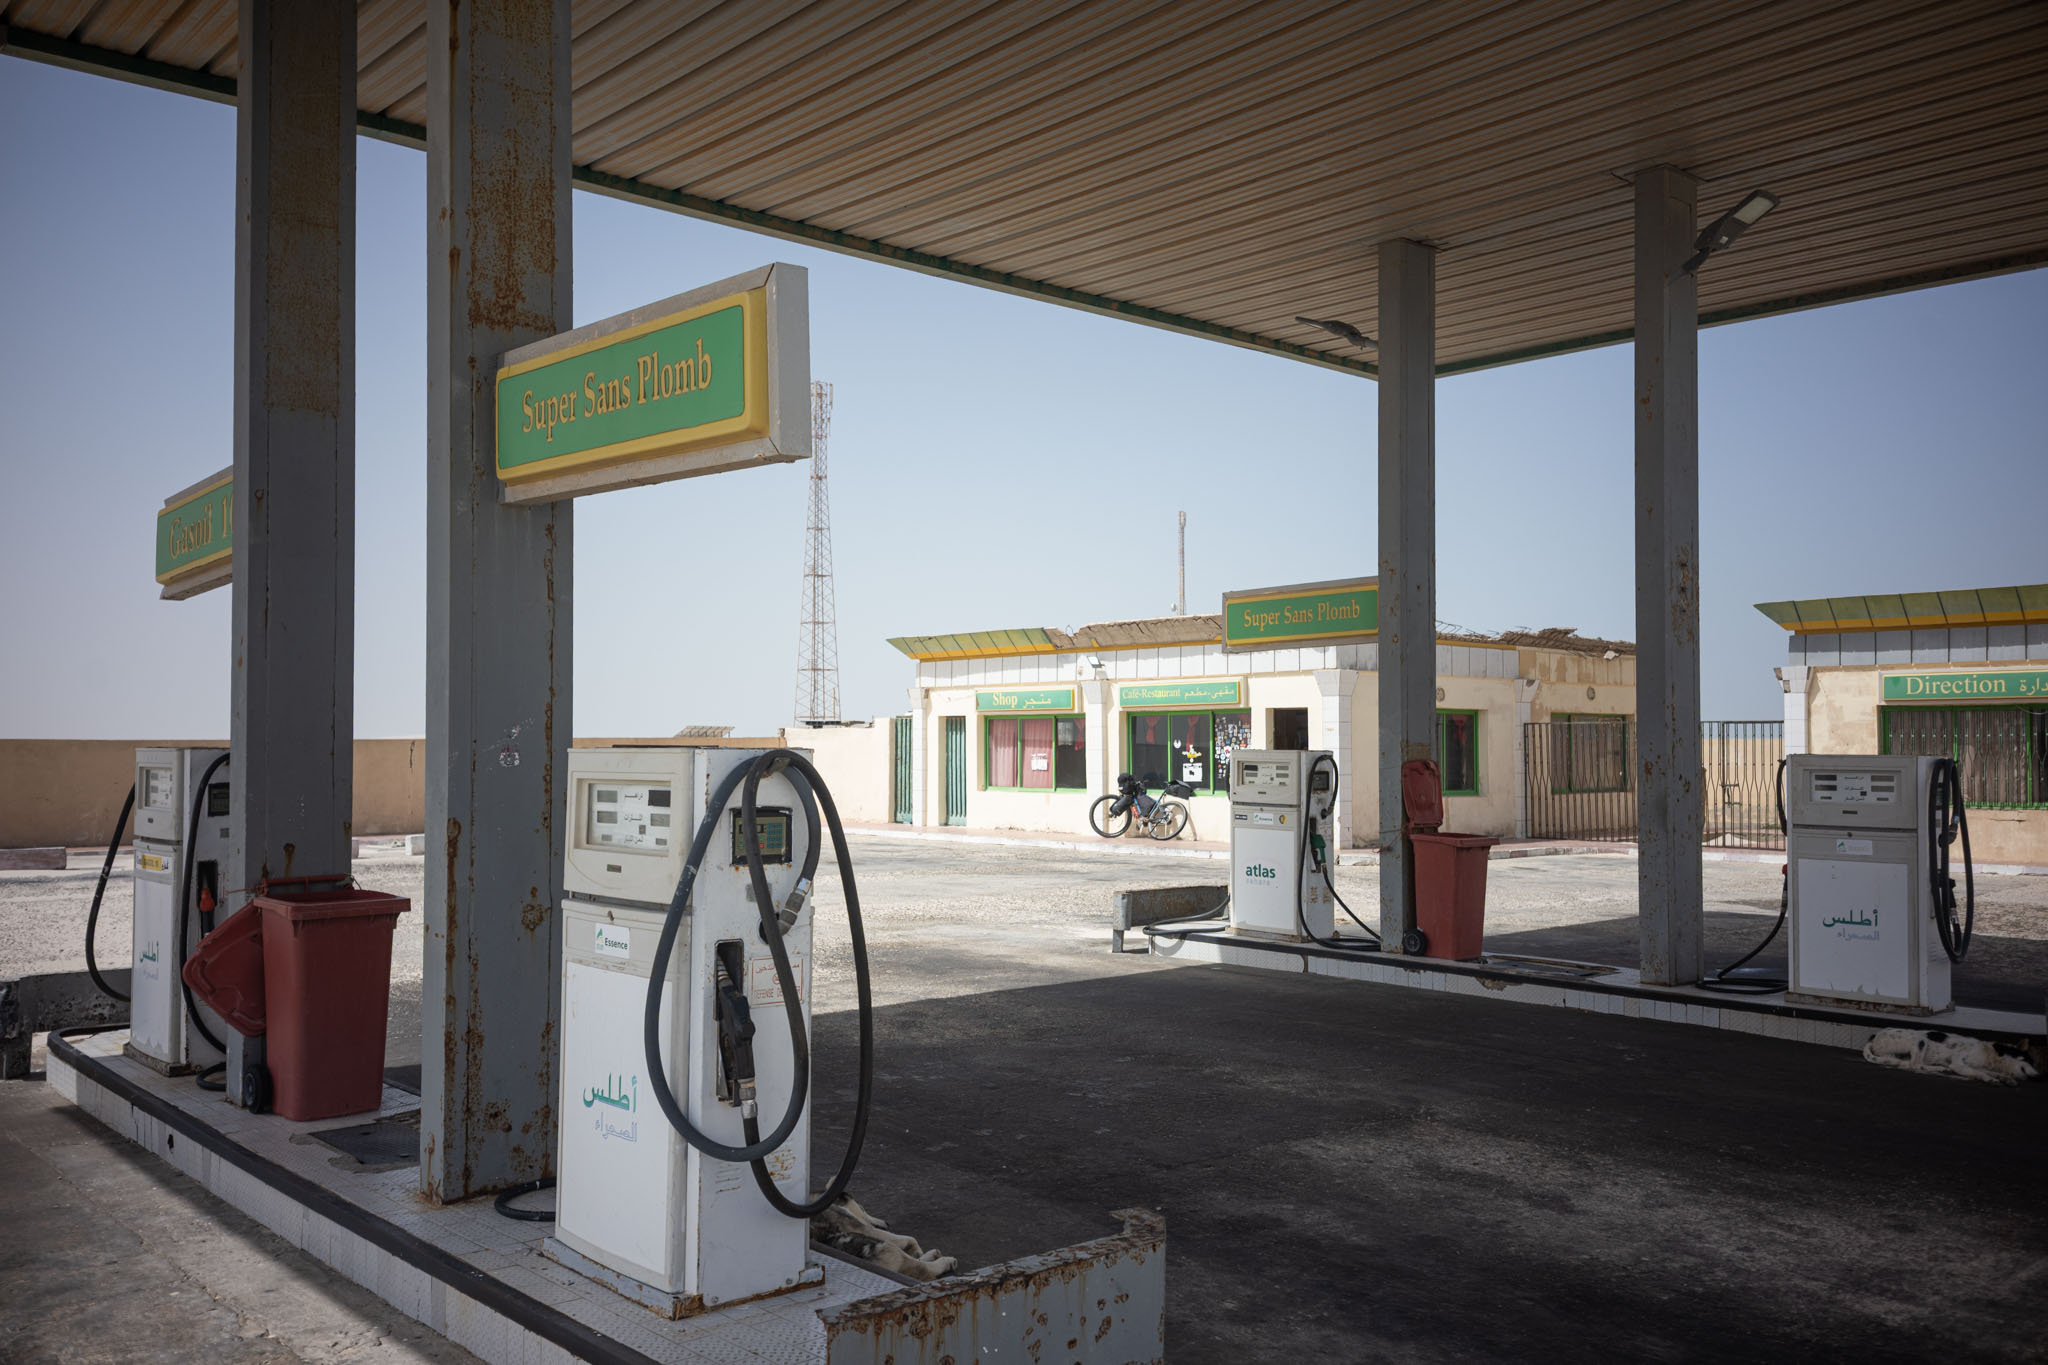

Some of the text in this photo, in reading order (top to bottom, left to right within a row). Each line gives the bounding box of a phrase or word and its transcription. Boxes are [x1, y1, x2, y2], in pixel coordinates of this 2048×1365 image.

[522, 338, 713, 442] Super Sans Plomb
[168, 503, 213, 559] Gasoil
[1243, 599, 1361, 631] Super Sans Plomb
[1905, 674, 2007, 695] Direction
[992, 691, 1018, 709] Shop
[1245, 863, 1276, 879] atlas
[1822, 909, 1879, 927] أطلس
[604, 937, 628, 950] Essence
[583, 1071, 638, 1113] أطلس
